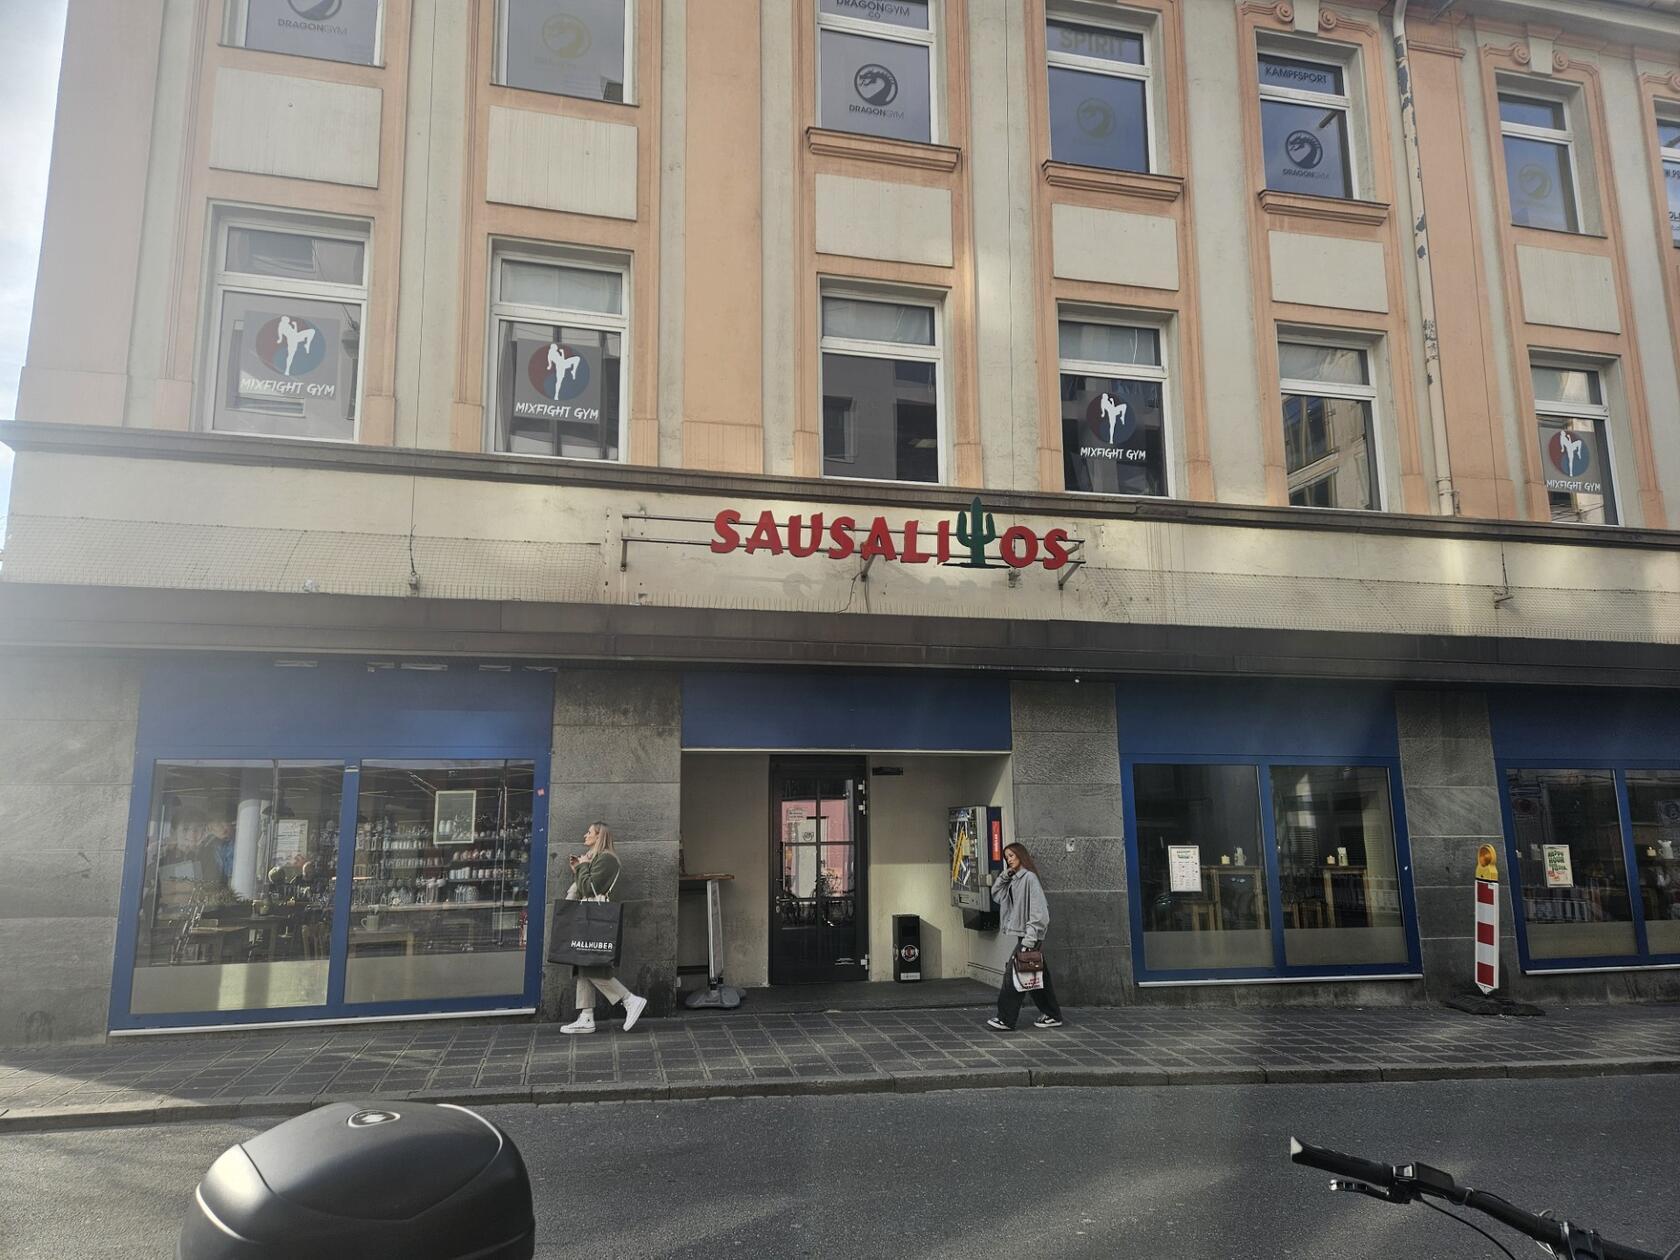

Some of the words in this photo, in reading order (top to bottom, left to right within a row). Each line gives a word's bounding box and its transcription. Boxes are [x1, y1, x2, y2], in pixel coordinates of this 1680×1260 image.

[836, 0, 910, 17] DRAGONGYM
[277, 18, 348, 36] DRAGONGYM
[1060, 29, 1126, 55] SPIRIT
[1264, 66, 1327, 84] KAMPFSPORT
[848, 104, 904, 119] DRAGONGYM
[240, 377, 304, 394] MIXFIGHT
[306, 383, 335, 397] GYM
[515, 402, 571, 418] MIXFIGHT
[573, 407, 599, 421] GYM
[1080, 447, 1124, 459] MIXFIGHT
[1126, 449, 1146, 460] GYM
[1546, 479, 1582, 491] MIXFIGHT
[1584, 482, 1601, 492] GYM
[570, 940, 613, 950] HALLHUBER
